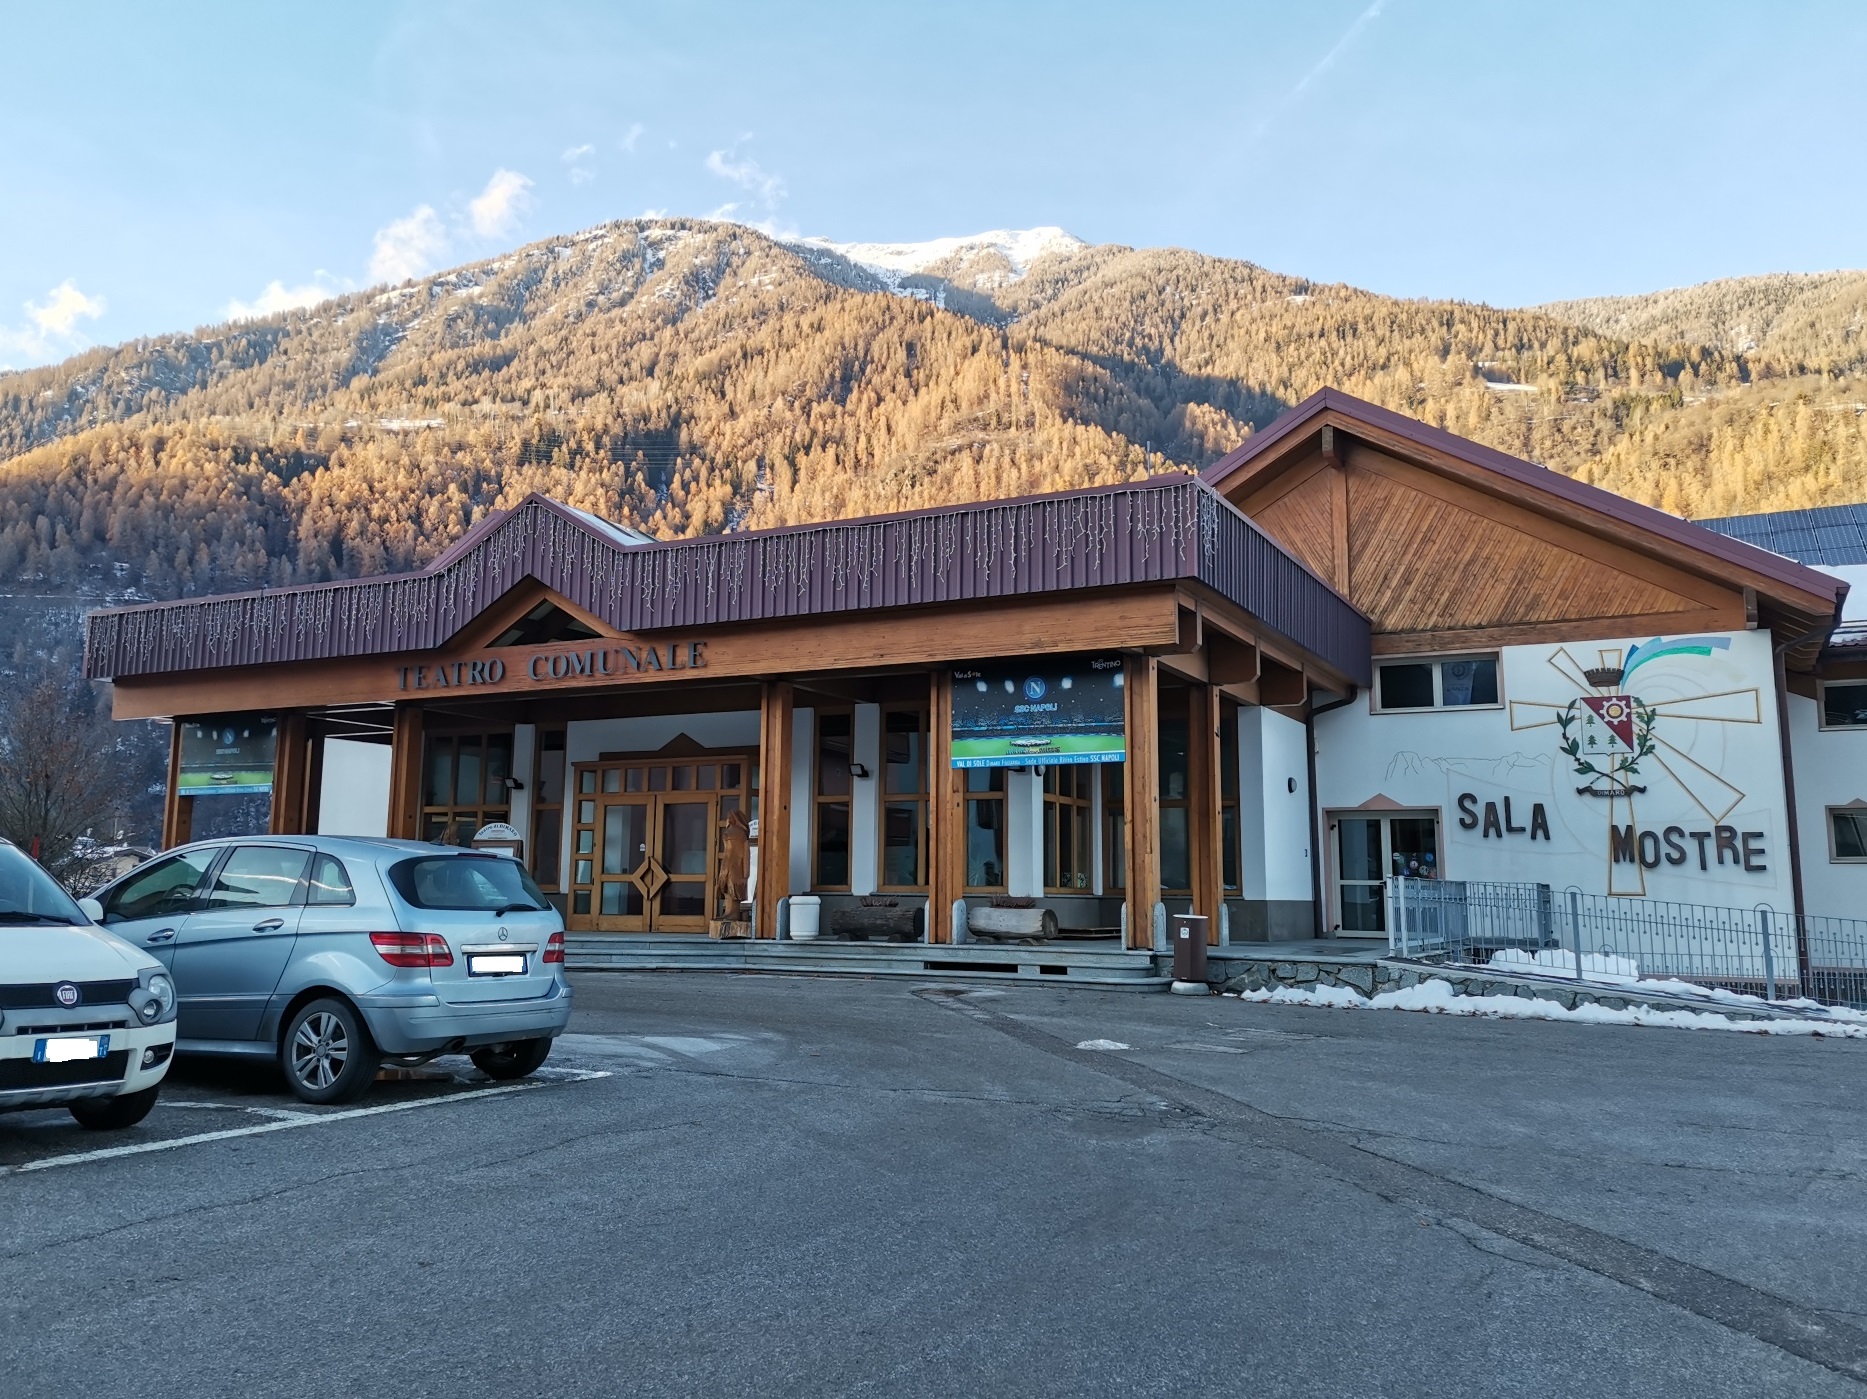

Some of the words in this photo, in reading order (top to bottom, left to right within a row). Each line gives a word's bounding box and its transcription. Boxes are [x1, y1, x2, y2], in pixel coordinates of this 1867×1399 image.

[398, 658, 506, 692] TEATRO
[527, 640, 708, 682] COMUNALE
[1029, 681, 1041, 695] N
[1014, 704, 1030, 714] SSC
[1031, 702, 1058, 713] NAPOLI
[956, 760, 966, 768] VAL
[973, 759, 986, 767] SOLE
[1090, 754, 1100, 762] SSC
[1101, 753, 1120, 762] NAPOLI
[1457, 792, 1551, 843] SALA
[1610, 822, 1768, 873] MOSTRE
[62, 990, 74, 1000] FIAT
